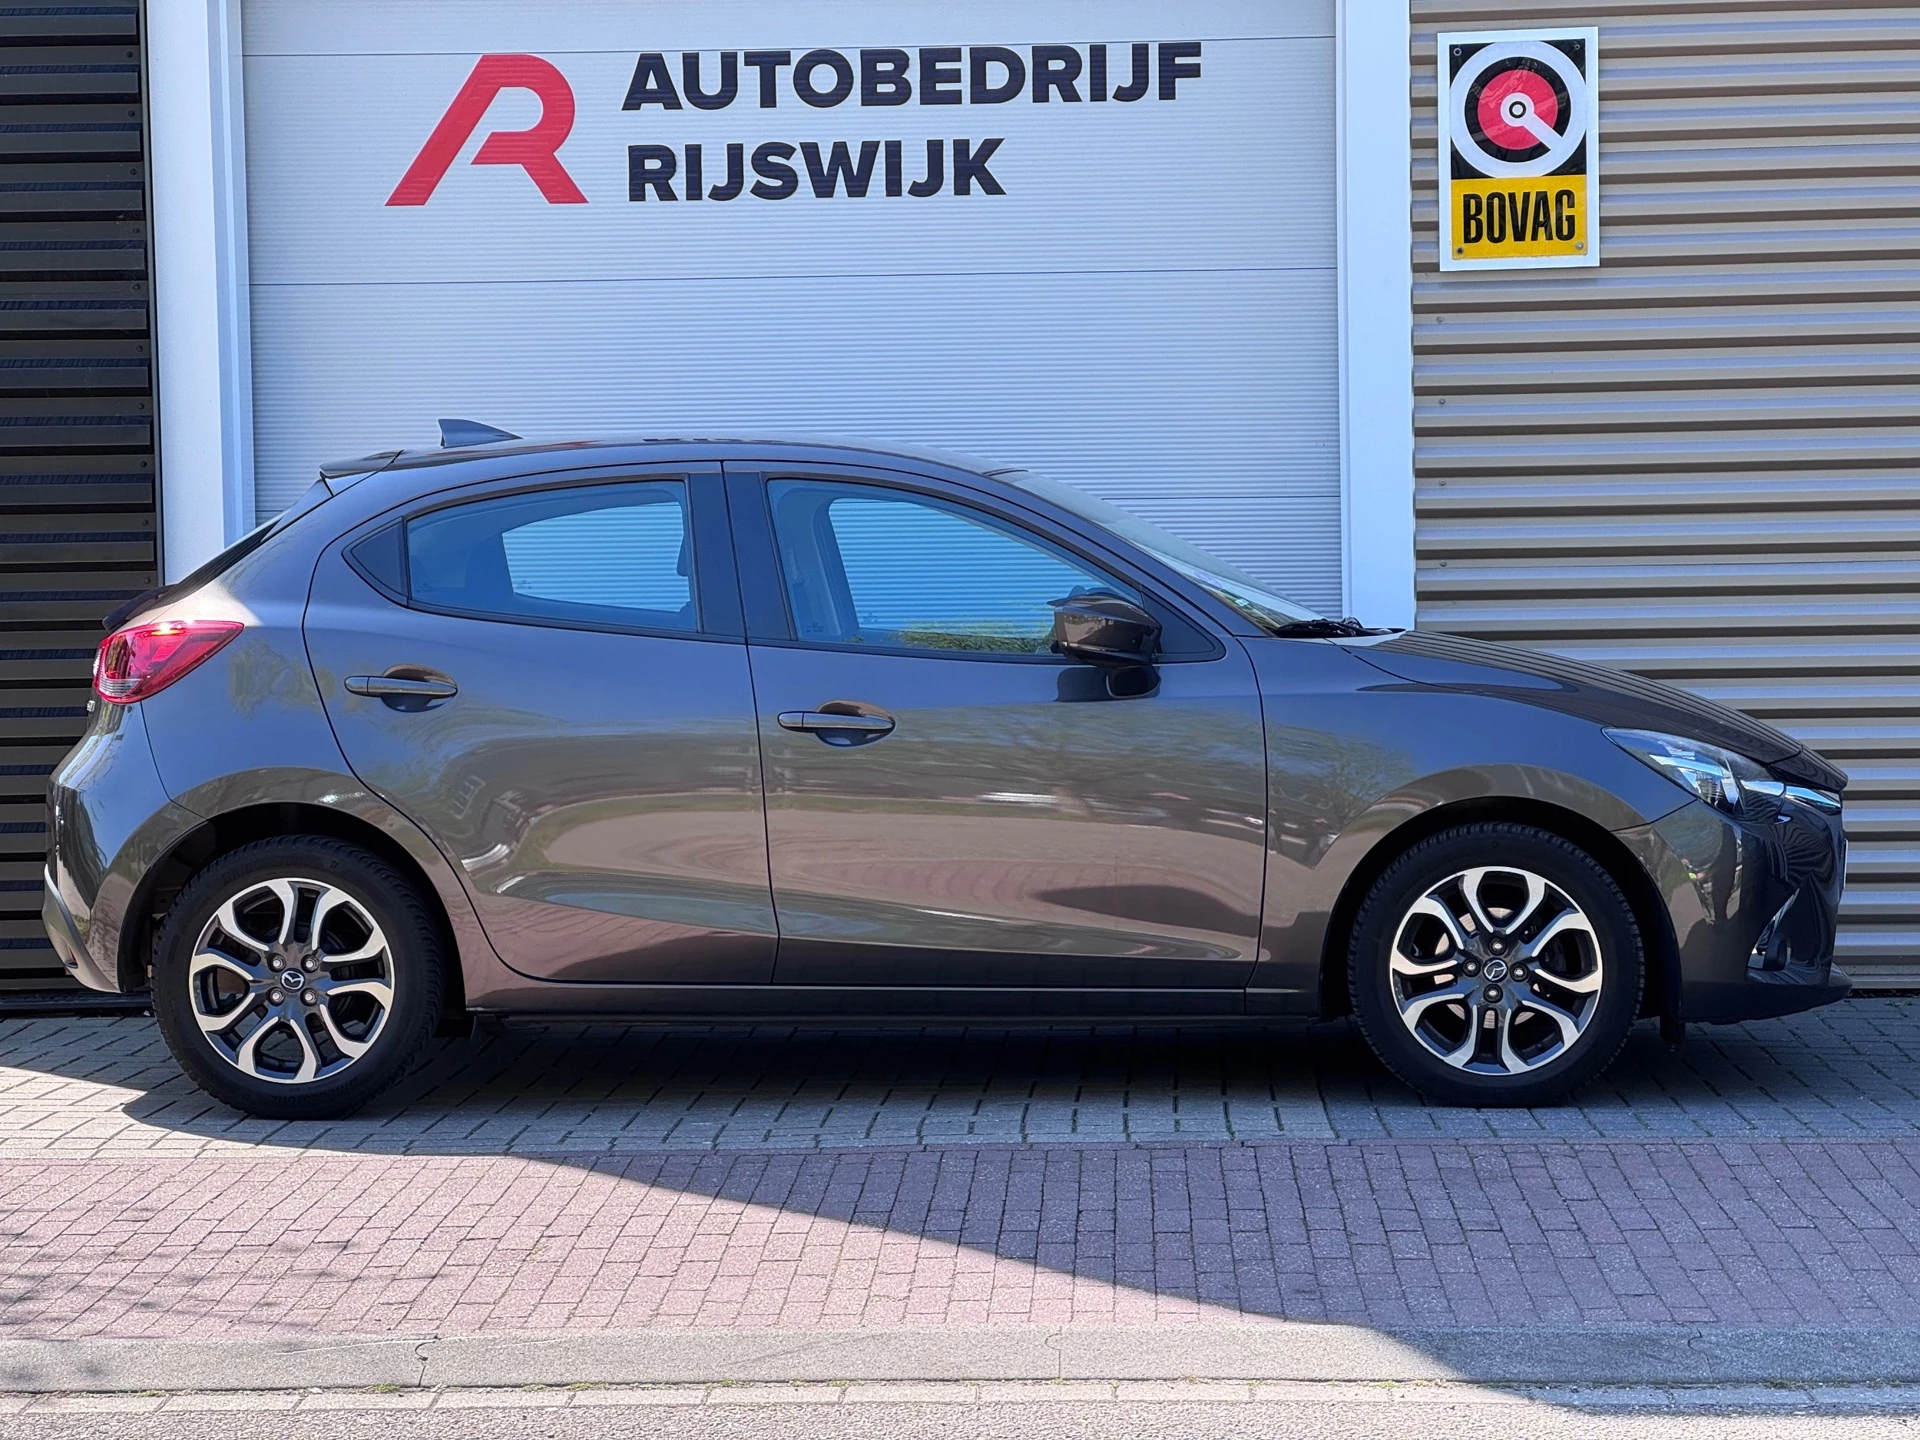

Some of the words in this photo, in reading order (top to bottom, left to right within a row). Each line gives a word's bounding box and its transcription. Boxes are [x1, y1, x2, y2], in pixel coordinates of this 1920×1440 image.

[621, 41, 1202, 111] AUTOBEDRIJF
[627, 138, 1007, 202] RIJSWIJK
[1462, 189, 1576, 244] BOVAG
